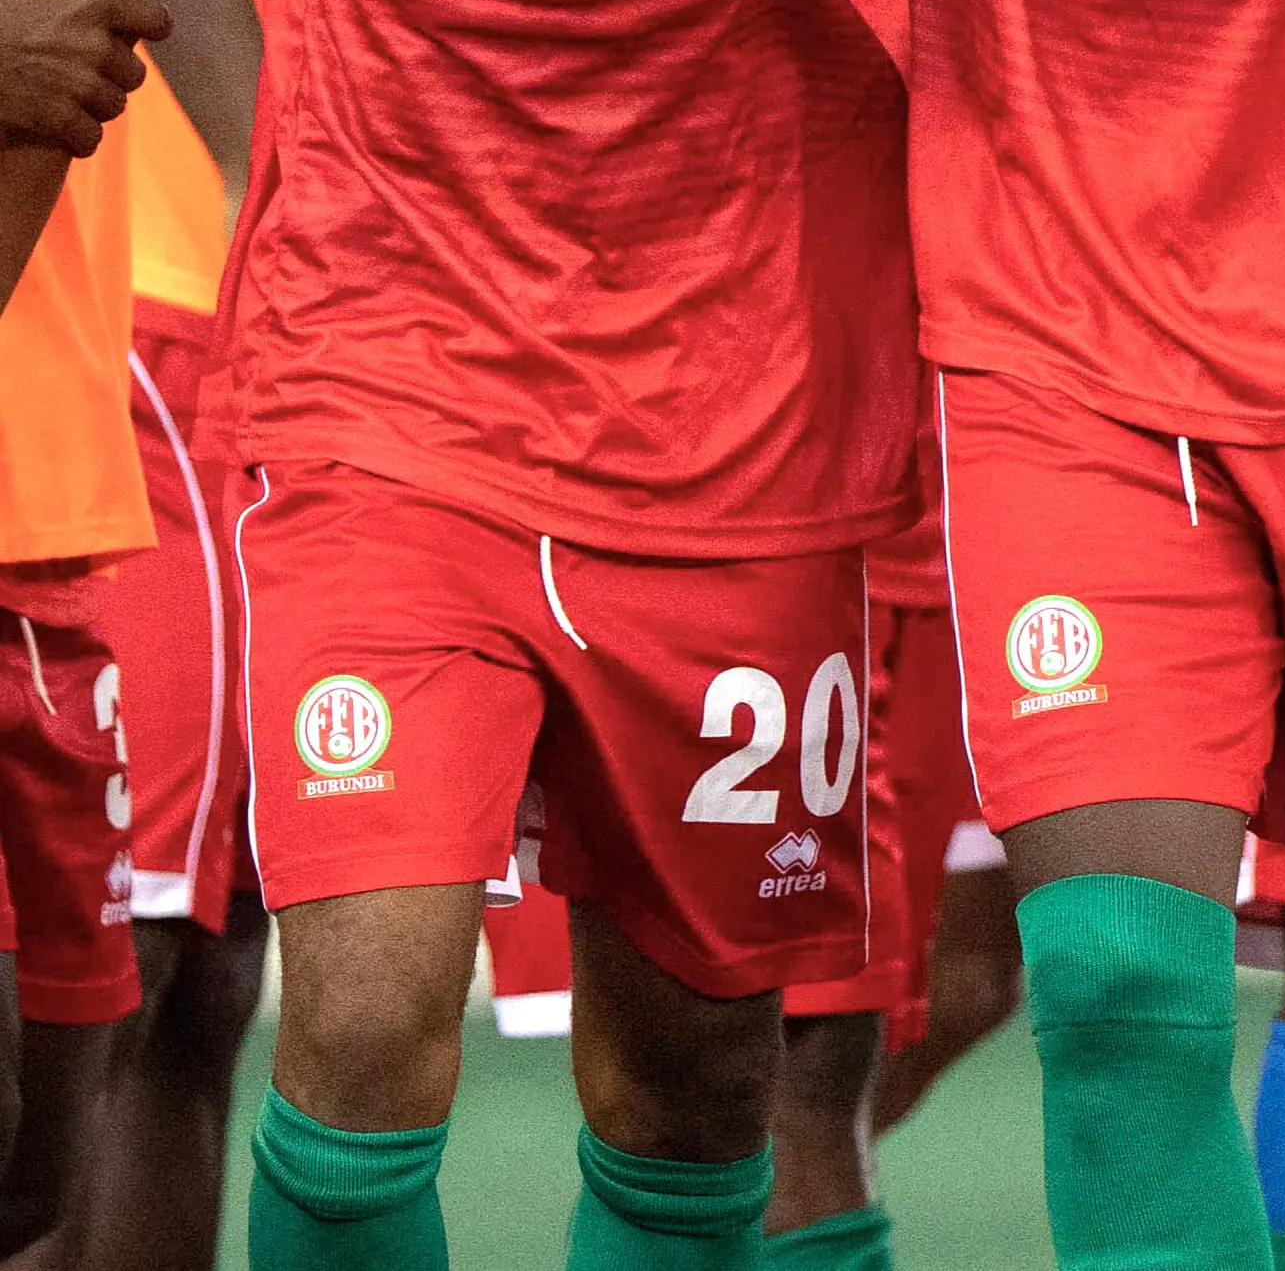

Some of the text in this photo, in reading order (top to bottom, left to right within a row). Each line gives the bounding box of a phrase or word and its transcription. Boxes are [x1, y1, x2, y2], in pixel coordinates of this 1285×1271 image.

[1020, 688, 1098, 714] BURUNDI
[682, 652, 859, 825] 20
[306, 775, 384, 796] BURUNDI
